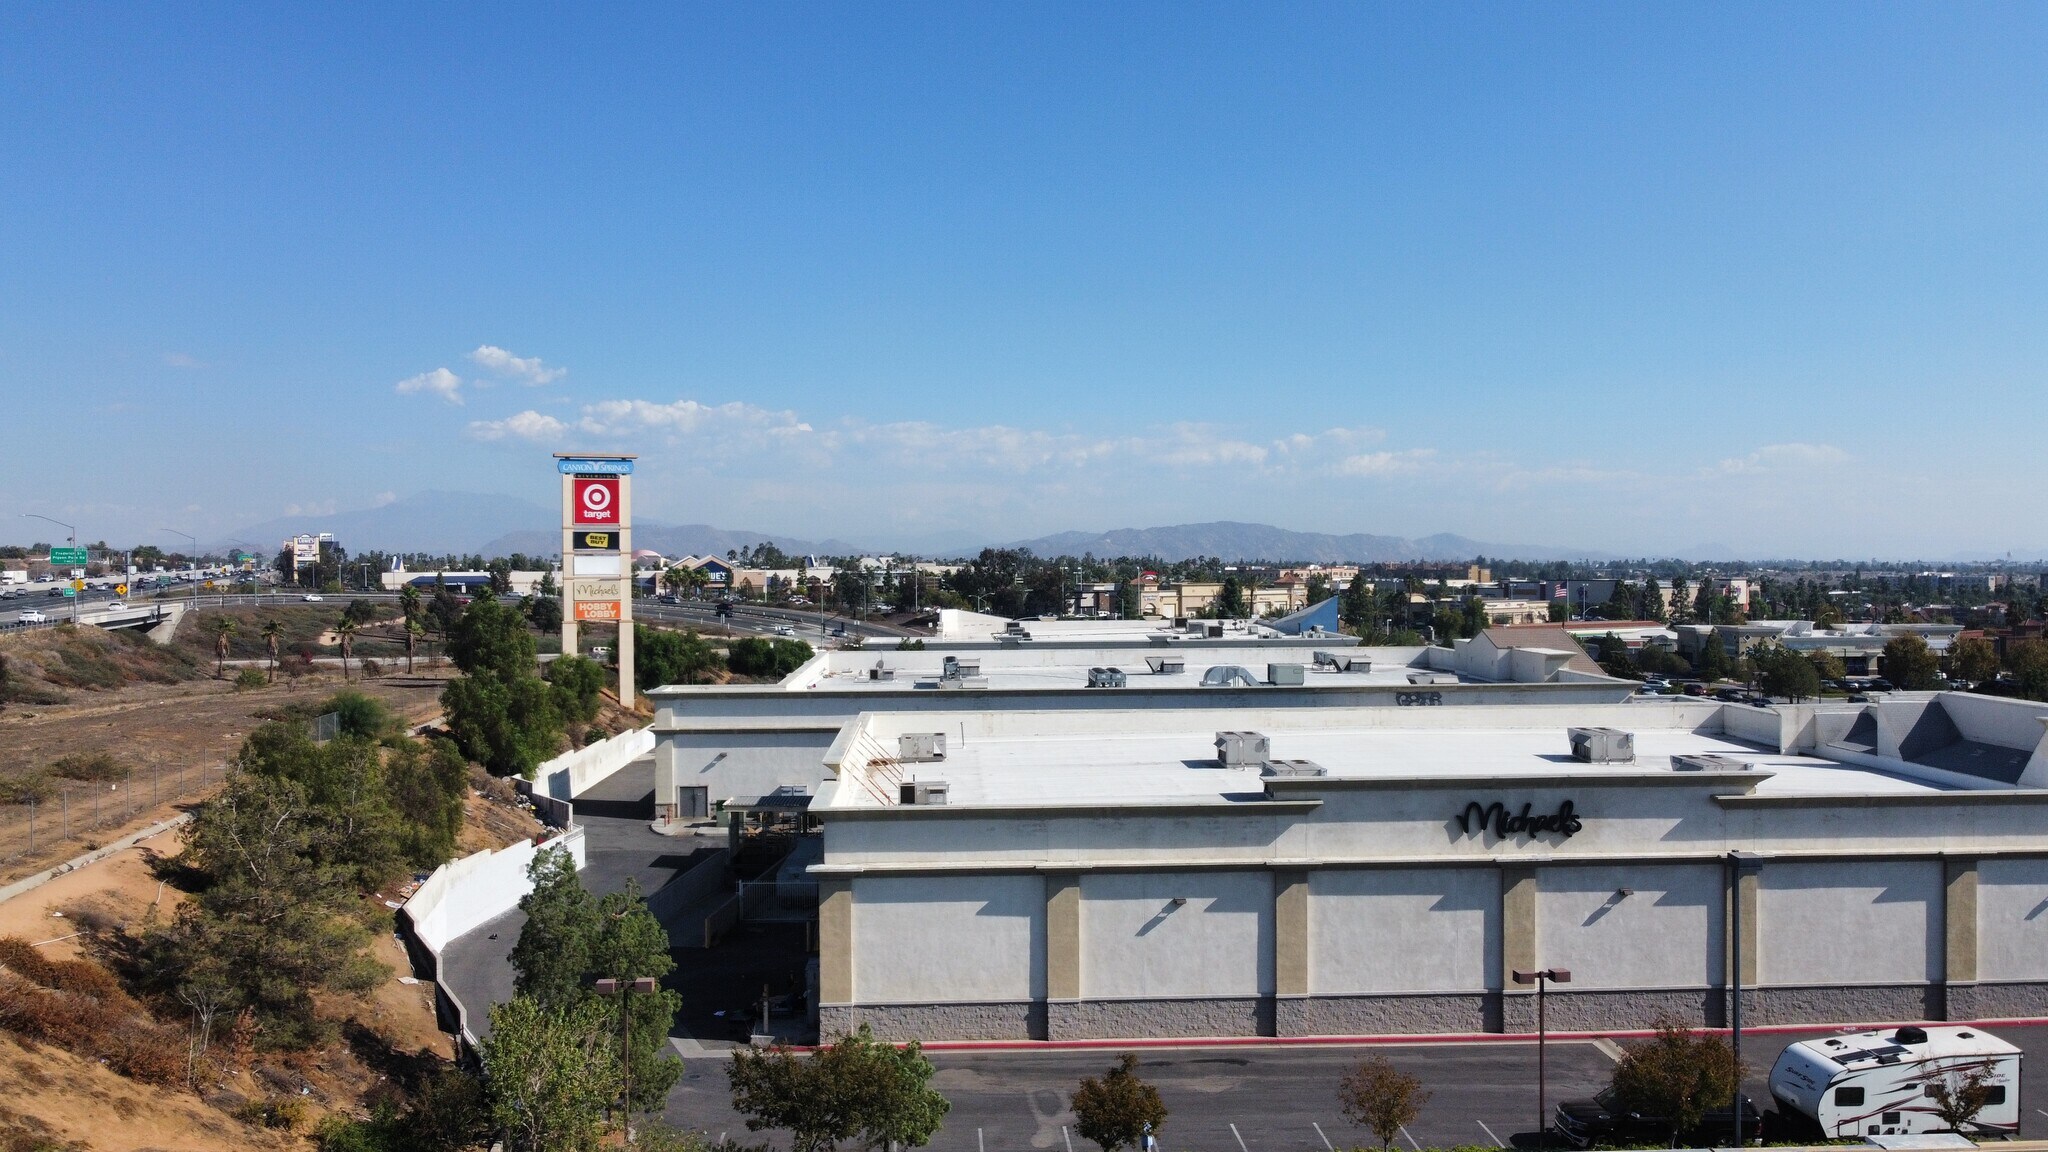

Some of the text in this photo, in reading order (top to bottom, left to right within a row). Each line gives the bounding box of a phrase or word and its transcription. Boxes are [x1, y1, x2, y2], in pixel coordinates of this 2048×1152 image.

[563, 463, 629, 472] CANYON SPRINGS
[583, 510, 611, 520] target
[576, 584, 619, 598] Michaels
[579, 602, 613, 611] HOBBY
[584, 610, 617, 618] LOBBY
[1456, 799, 1583, 839] Michaels
